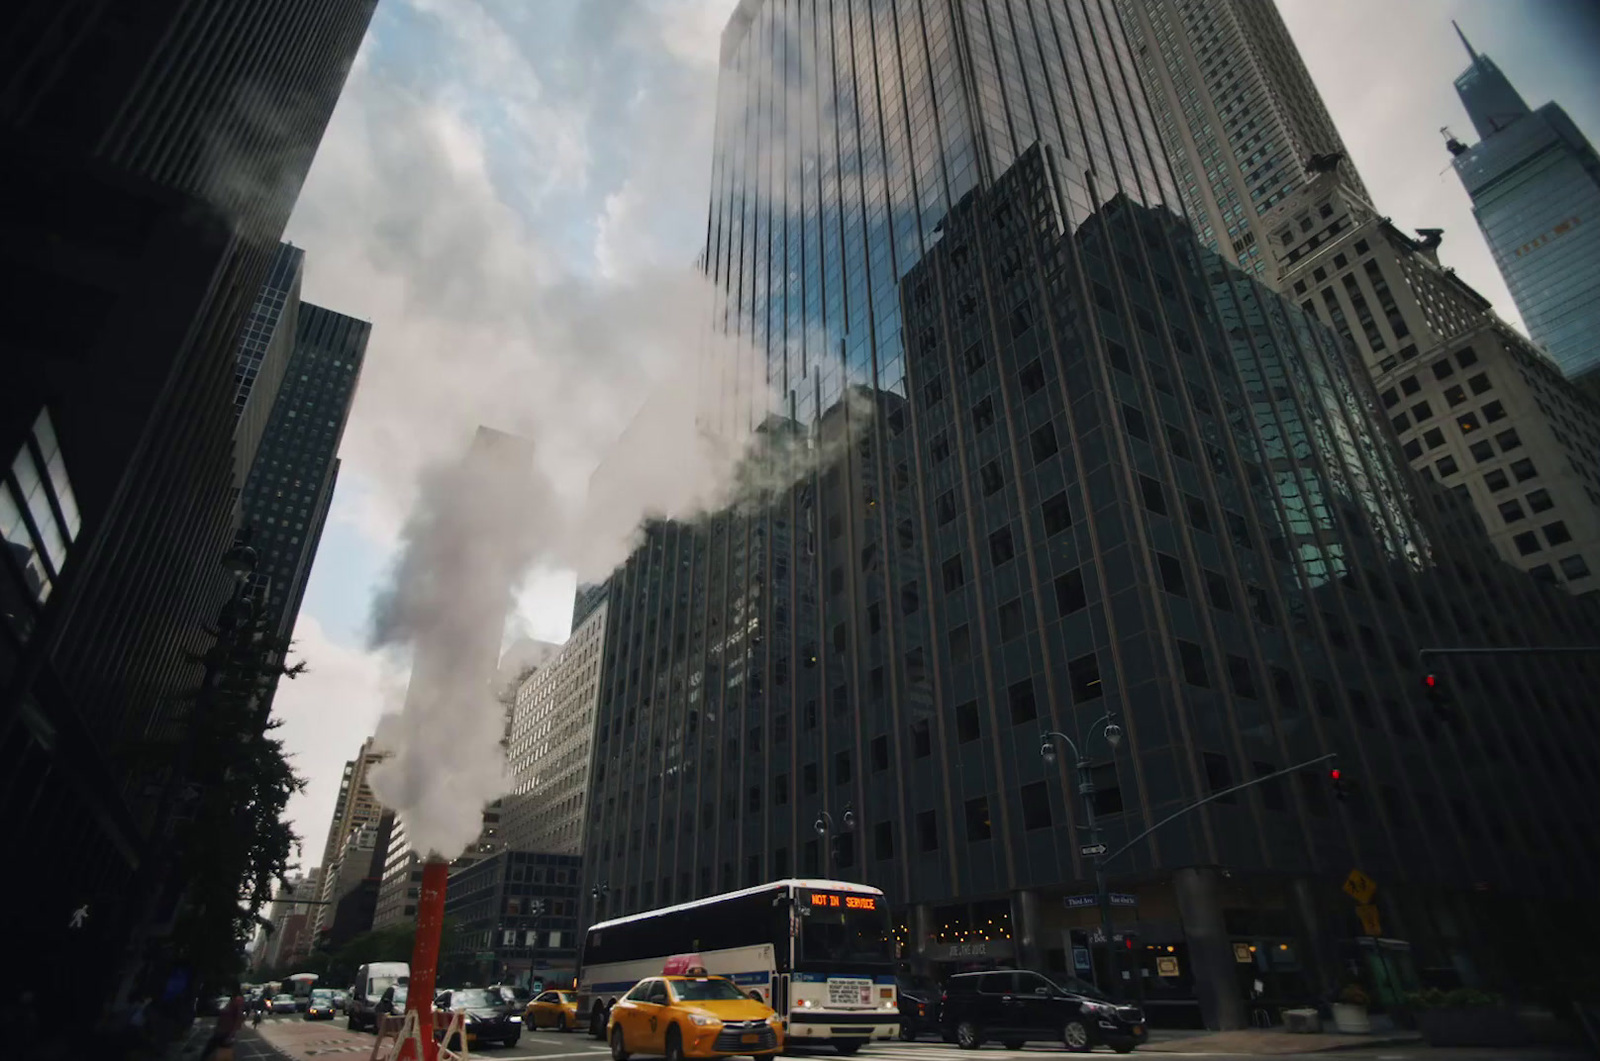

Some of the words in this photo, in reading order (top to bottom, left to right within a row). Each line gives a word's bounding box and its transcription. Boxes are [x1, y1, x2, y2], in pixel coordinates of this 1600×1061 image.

[811, 894, 828, 906] NOT
[829, 895, 840, 907] IN
[846, 896, 876, 910] SERVICE
